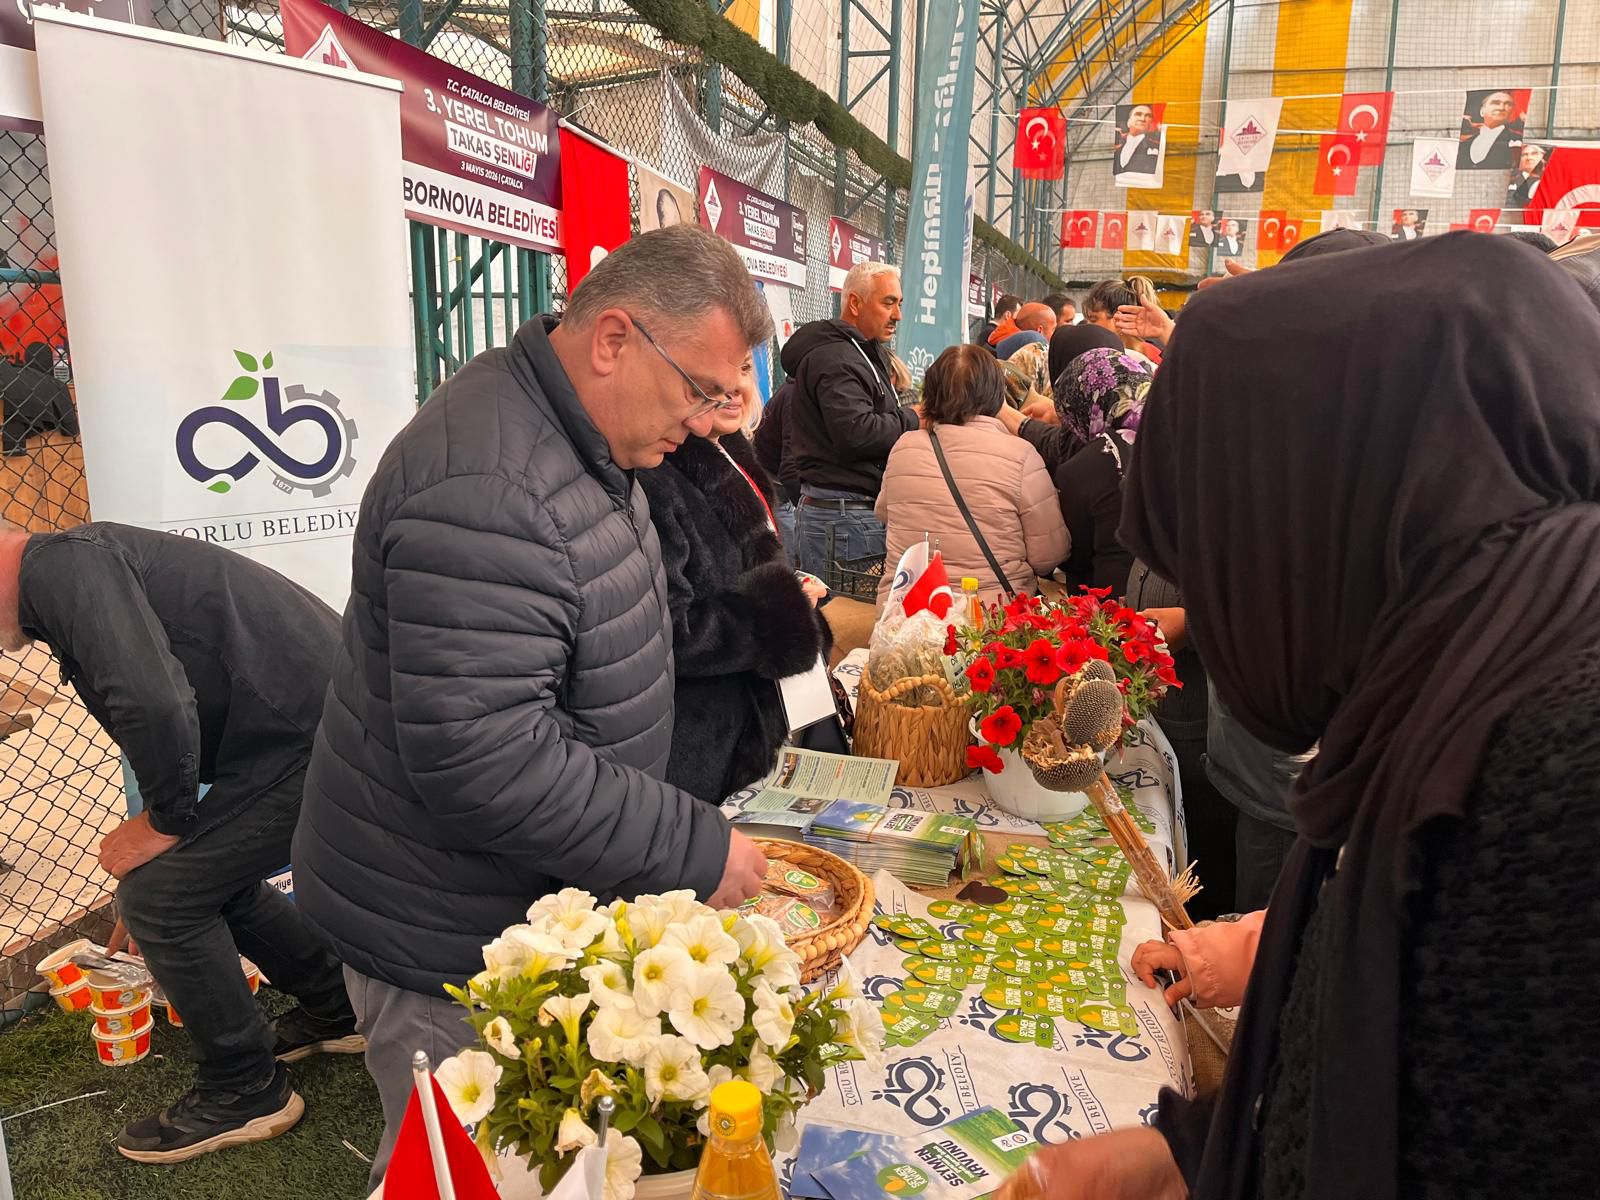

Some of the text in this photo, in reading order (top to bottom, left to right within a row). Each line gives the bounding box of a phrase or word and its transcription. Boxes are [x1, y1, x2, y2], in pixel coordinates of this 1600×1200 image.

[424, 88, 548, 155] 3. YEREL TOHUM
[446, 78, 530, 122] T.C. ÇATALCA BELEDİYESİ
[450, 128, 535, 174] TAKAS ŞENLİĞİ
[466, 162, 484, 177] MAYIS
[500, 174, 524, 190] ÇATALCA
[402, 176, 559, 241] BORNOVA BELEDİYESİ
[914, 1148, 964, 1187] SEYMEN
[940, 1140, 990, 1178] KAVUNU
